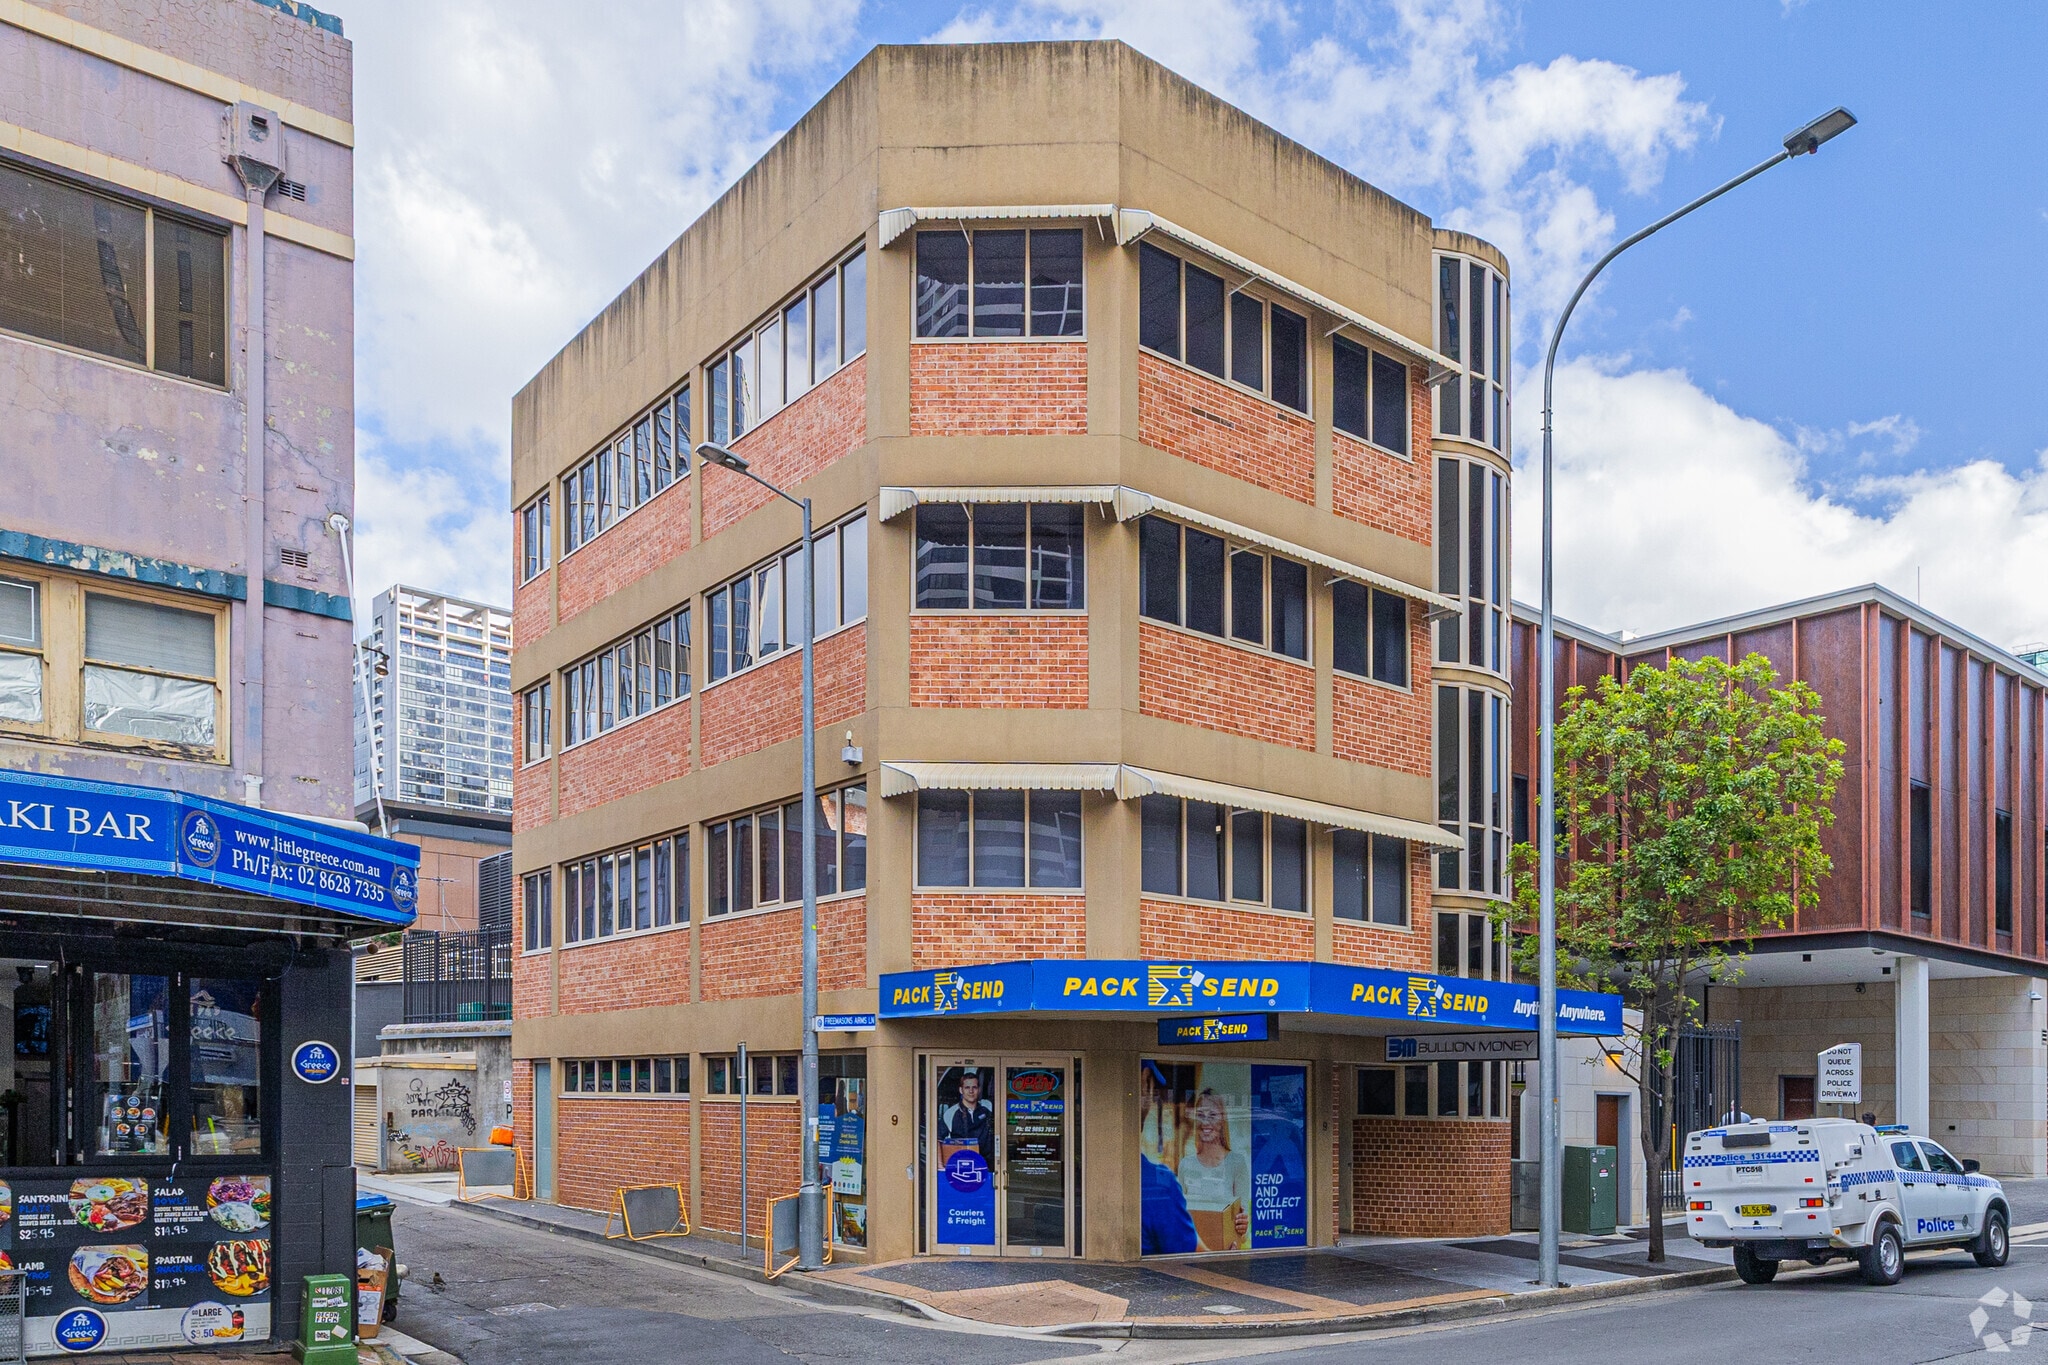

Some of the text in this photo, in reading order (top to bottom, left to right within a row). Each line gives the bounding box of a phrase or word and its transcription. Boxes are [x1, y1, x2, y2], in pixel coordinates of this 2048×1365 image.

[66, 807, 154, 842] BAR
[188, 834, 214, 850] Greece
[235, 830, 380, 878] www.littlegreece.com.au
[232, 848, 384, 902] Ph/Fax: 02 8628 7335
[893, 980, 1004, 1005] PACK SEND
[1063, 977, 1279, 997] PACK SEND
[1351, 983, 1488, 1013] PACK SEND
[1559, 1004, 1606, 1021] Anywhere.
[1177, 1024, 1248, 1037] PACK SEND
[1418, 1041, 1476, 1053] BULLION
[1478, 1040, 1534, 1052] MONEY
[300, 1060, 331, 1070] Greece
[1012, 1076, 1055, 1091] OPEN
[891, 1114, 898, 1126] 9
[1715, 1153, 1745, 1161] Police
[1255, 1174, 1283, 1184] SEND
[154, 1188, 184, 1196] SALAD
[1255, 1186, 1278, 1197] AND
[18, 1194, 69, 1204] SANTORINI
[153, 1197, 188, 1206] BOWLS
[1256, 1197, 1301, 1208] COLLECT
[1256, 1209, 1282, 1220] WITH
[1742, 1205, 1751, 1213] DL
[1752, 1205, 1760, 1213] 56
[956, 1217, 986, 1225] Freight
[1917, 1218, 1955, 1234] Police
[20, 1228, 55, 1240] $25.95
[154, 1225, 188, 1236] $14.95
[18, 1262, 45, 1270] LAMB
[155, 1256, 192, 1265] SPARTAN
[156, 1264, 205, 1274] SNACK PACK
[26, 1271, 51, 1280] YROS
[154, 1278, 186, 1289] $19.95
[198, 1308, 222, 1317] LARGE
[62, 1328, 98, 1338] Greece
